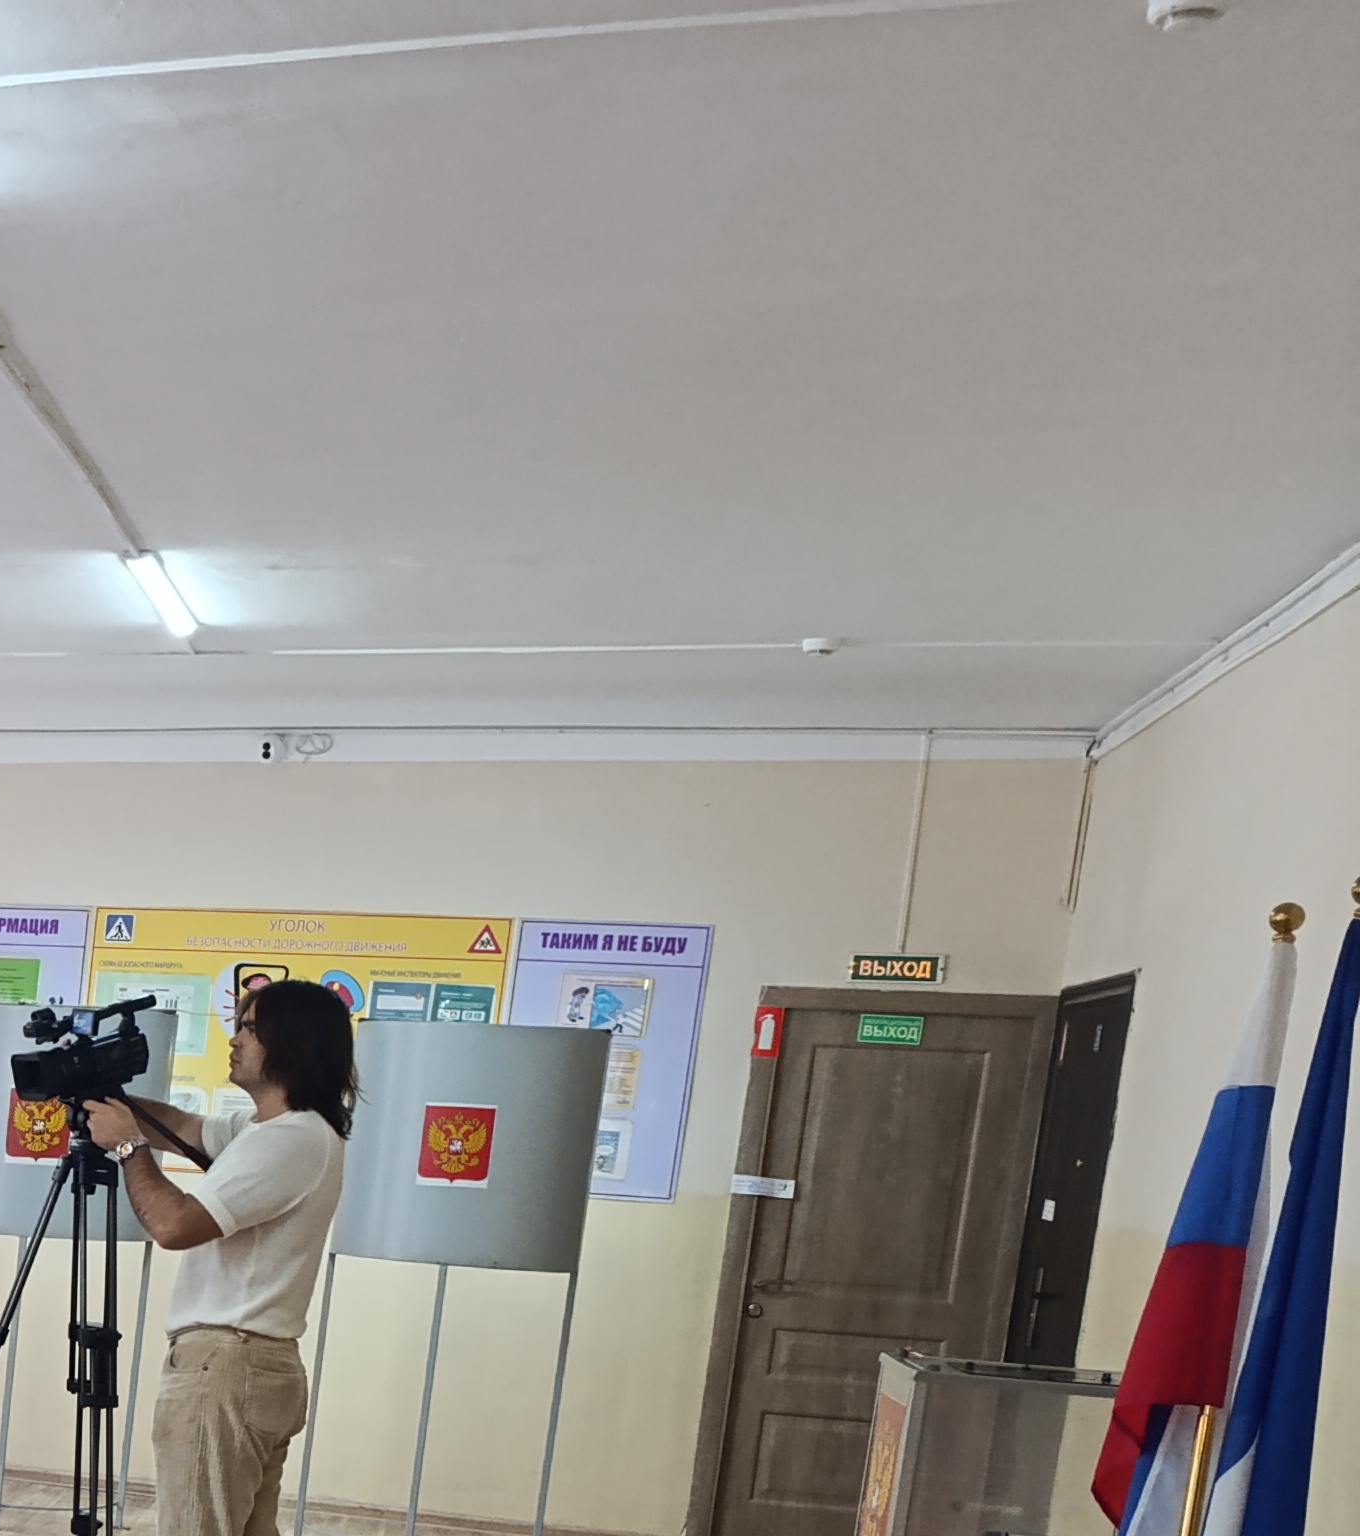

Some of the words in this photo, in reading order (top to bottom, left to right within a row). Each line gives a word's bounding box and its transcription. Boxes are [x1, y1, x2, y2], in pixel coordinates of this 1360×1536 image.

[270, 919, 325, 933] УГОЛОК
[186, 936, 271, 948] БЕЗОПАСНОСТИ
[273, 939, 343, 951] ДОРОЖНОГО
[345, 941, 408, 953] ДВИЖЕНИЯ
[541, 932, 598, 950] ТАКИМ
[602, 935, 613, 951] Я
[617, 935, 638, 951] НЕ
[641, 936, 687, 956] БУДУ
[859, 960, 931, 978] ВЫХОД
[863, 1025, 918, 1041] ВЫХОД
